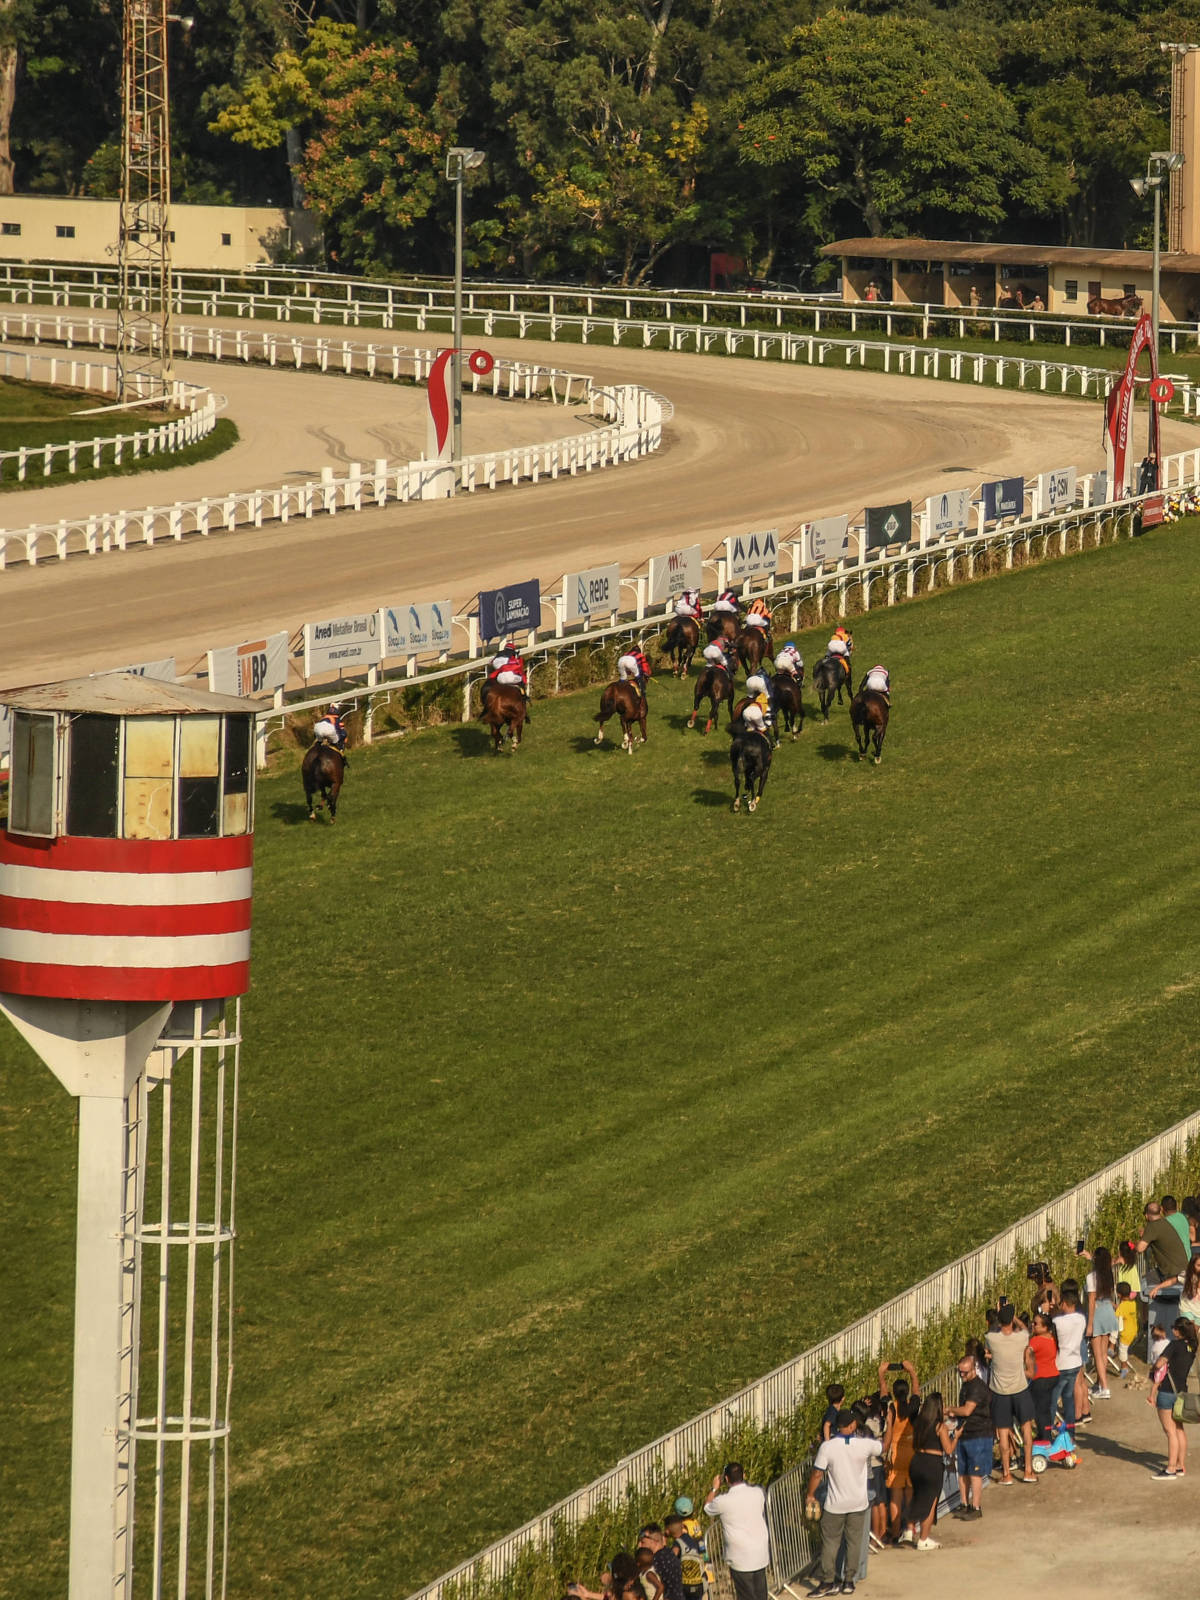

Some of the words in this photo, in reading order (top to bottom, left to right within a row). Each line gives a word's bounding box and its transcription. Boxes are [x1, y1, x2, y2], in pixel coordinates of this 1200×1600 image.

[1119, 390, 1130, 449] FESTIVAL
[1057, 478, 1068, 497] CSN
[508, 598, 522, 610] SUPER
[241, 653, 267, 695] MBP
